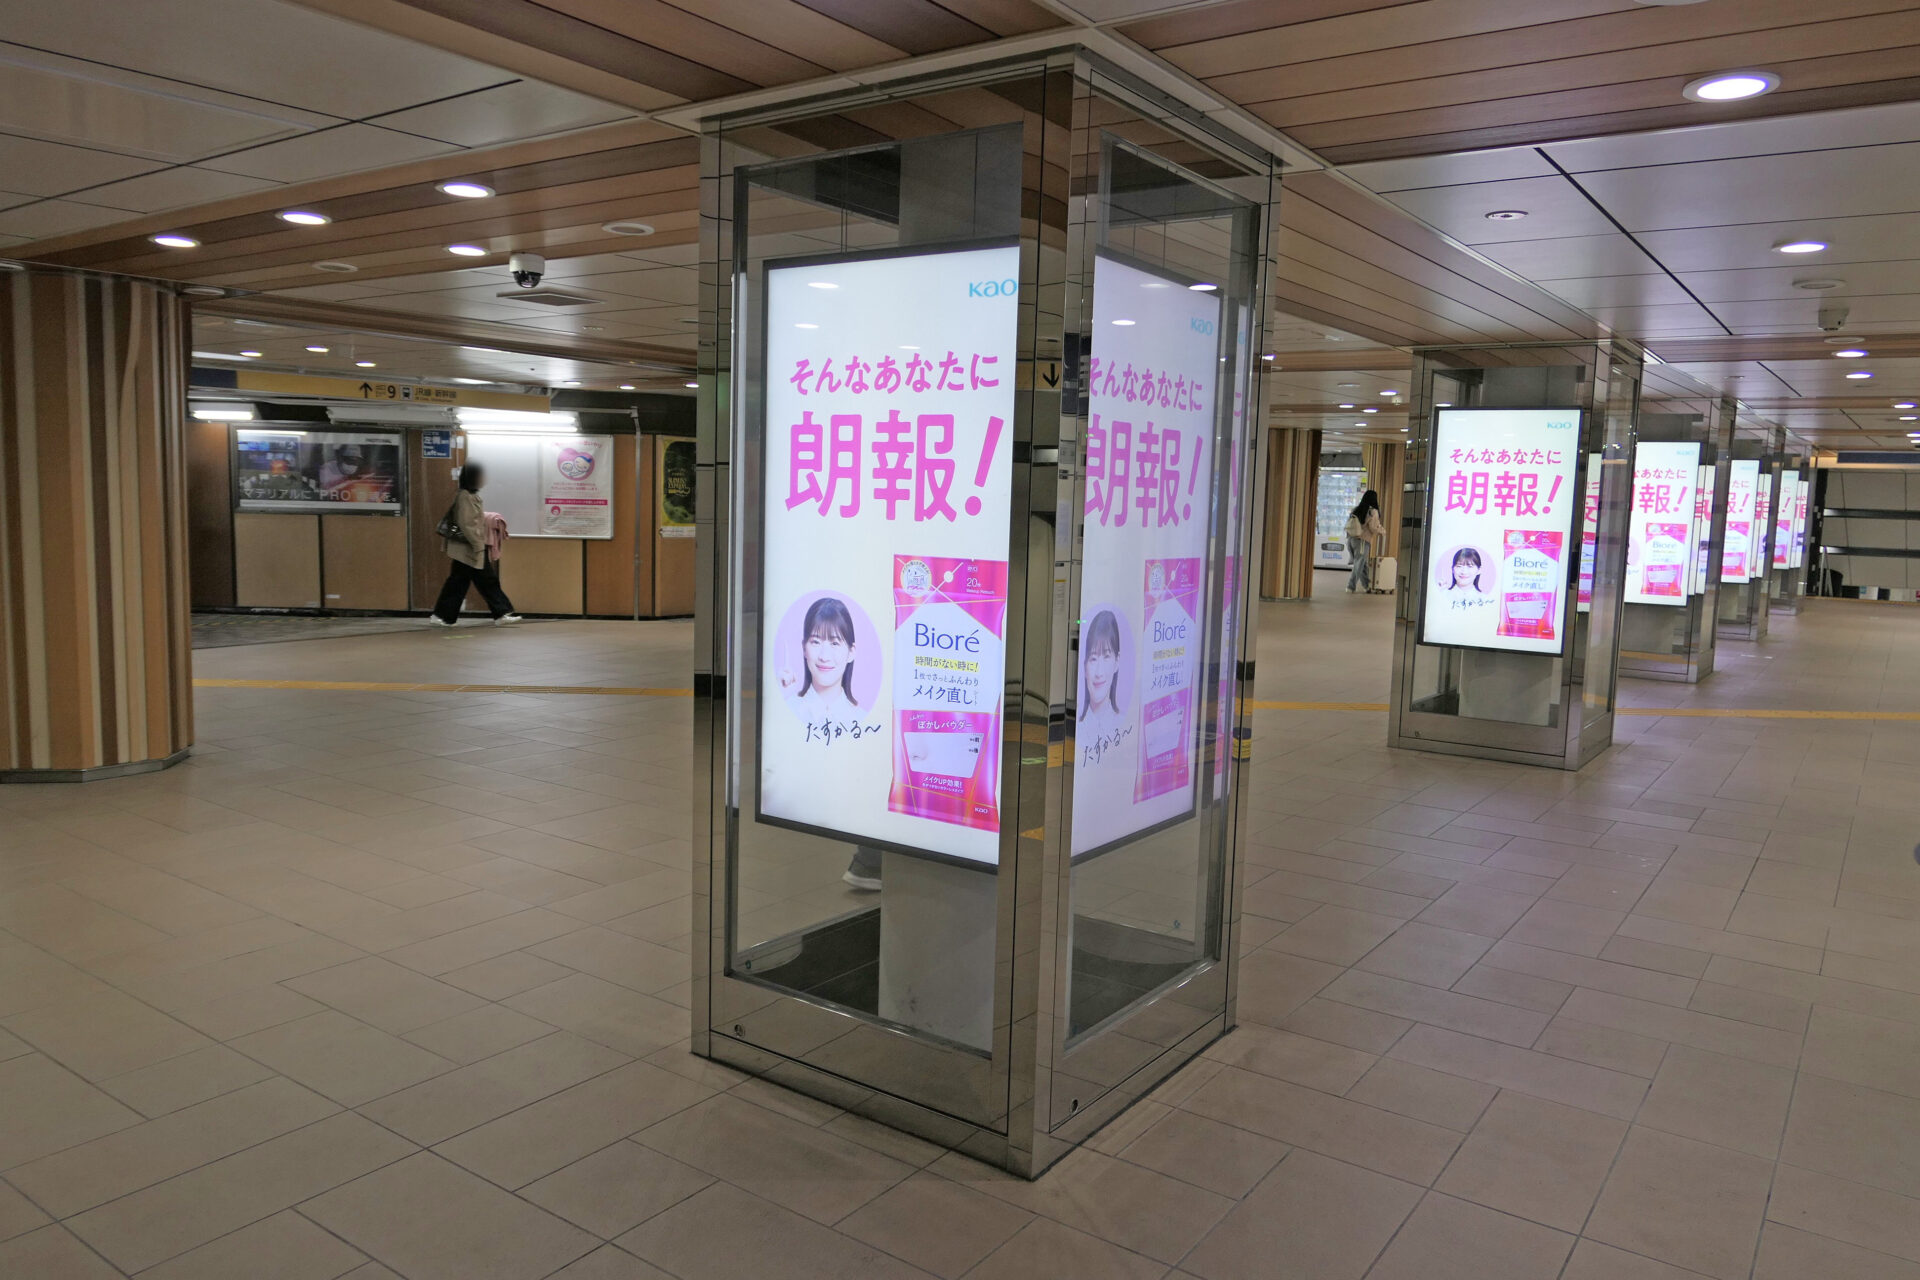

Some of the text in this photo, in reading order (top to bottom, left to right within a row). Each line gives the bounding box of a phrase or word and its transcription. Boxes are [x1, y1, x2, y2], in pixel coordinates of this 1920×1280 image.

[790, 351, 1000, 396] そんなあなたに
[1089, 357, 1203, 412] そんなあなたに
[387, 385, 396, 398] 9
[785, 409, 1005, 523] 朗報!
[1084, 413, 1203, 528] 朗報!
[1449, 448, 1562, 465] そんなあなたに
[1444, 470, 1563, 517] 朗報!
[914, 623, 980, 653] Bioré
[1153, 618, 1187, 643] Bioré
[913, 685, 973, 705] メイク直し
[917, 720, 973, 730] ぼかしパウダー
